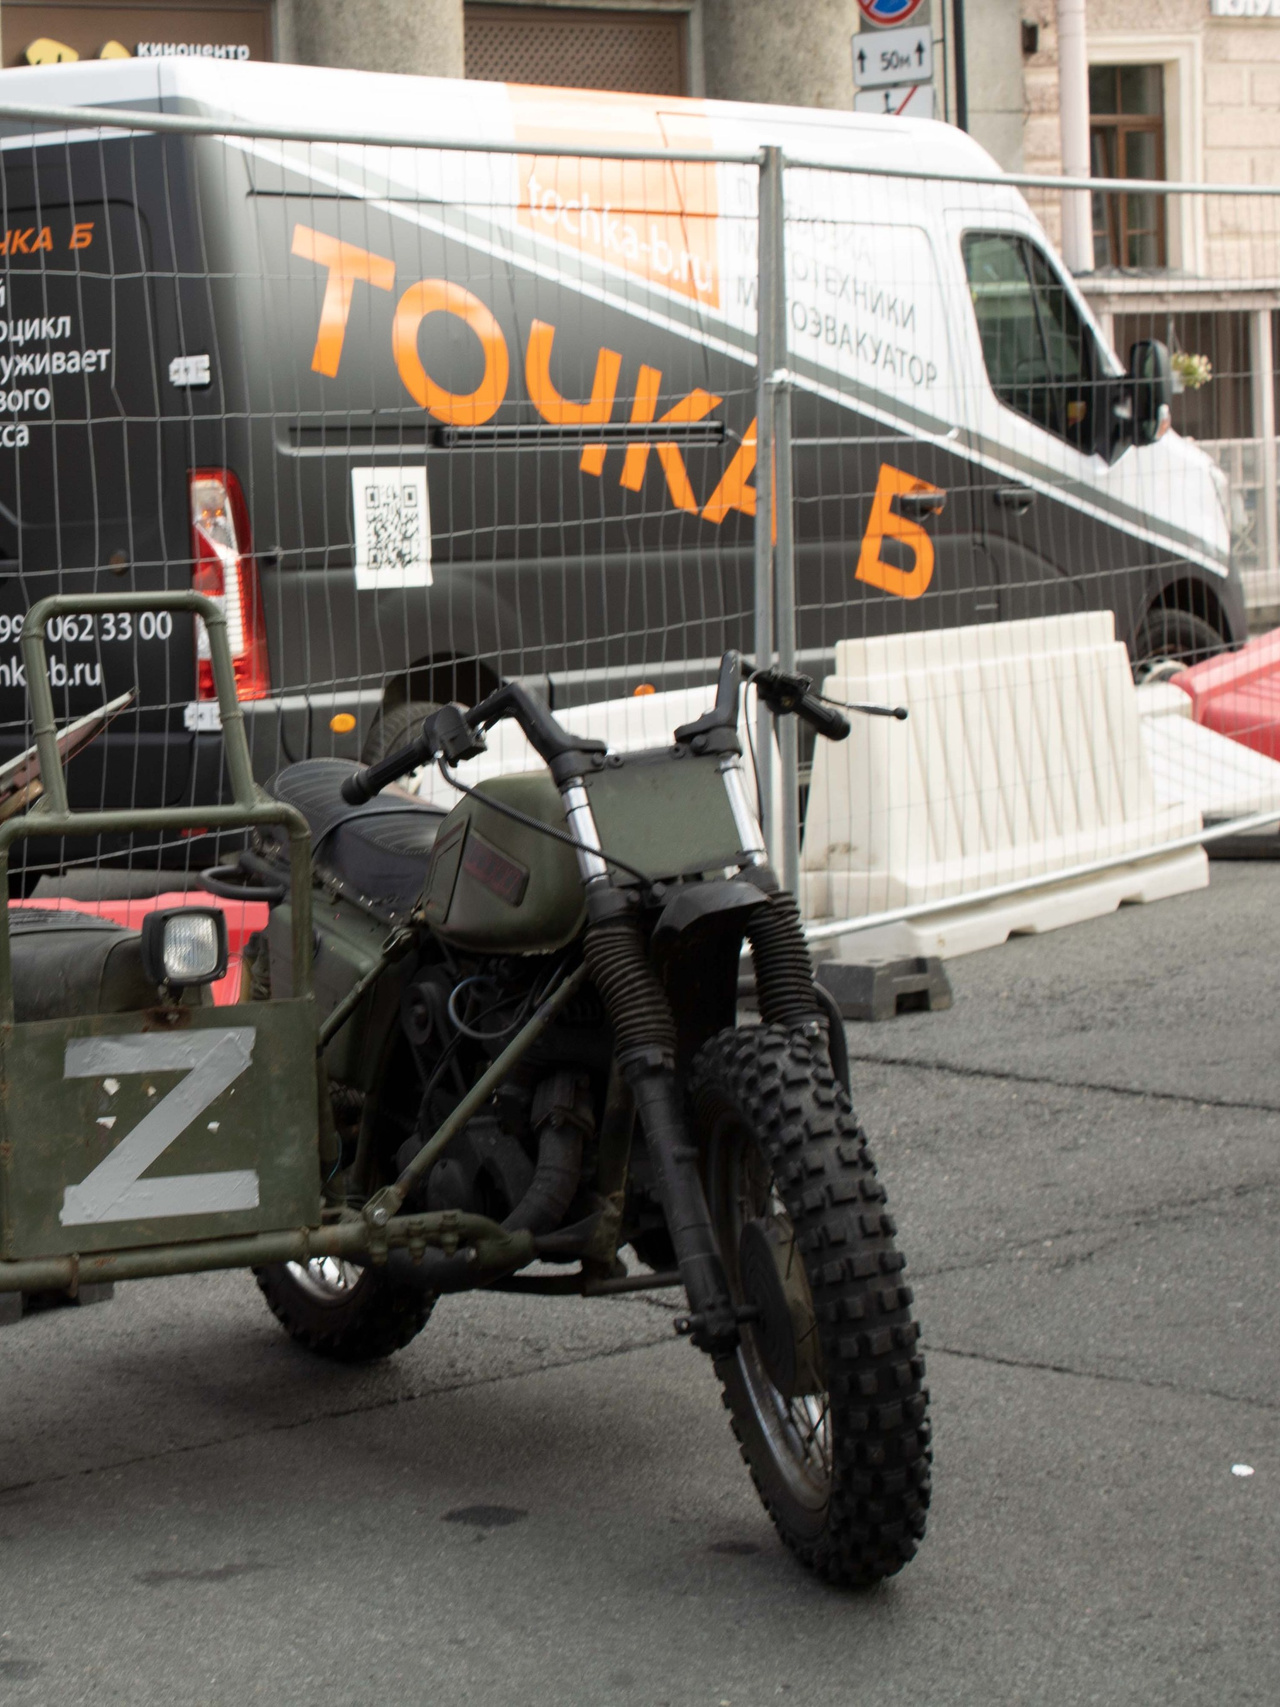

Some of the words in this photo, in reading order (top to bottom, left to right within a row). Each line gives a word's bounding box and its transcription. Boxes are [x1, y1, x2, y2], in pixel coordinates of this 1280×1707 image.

[69, 222, 95, 250] Б
[528, 174, 713, 293] tochka-b.ru
[737, 225, 916, 333] МОТЕХНИКИ
[737, 276, 938, 389] МОЭВАКУАТОР
[854, 463, 948, 599] Б
[46, 614, 95, 642] 062
[100, 612, 133, 641] 33
[139, 610, 173, 640] 00
[59, 1026, 259, 1226] Z
